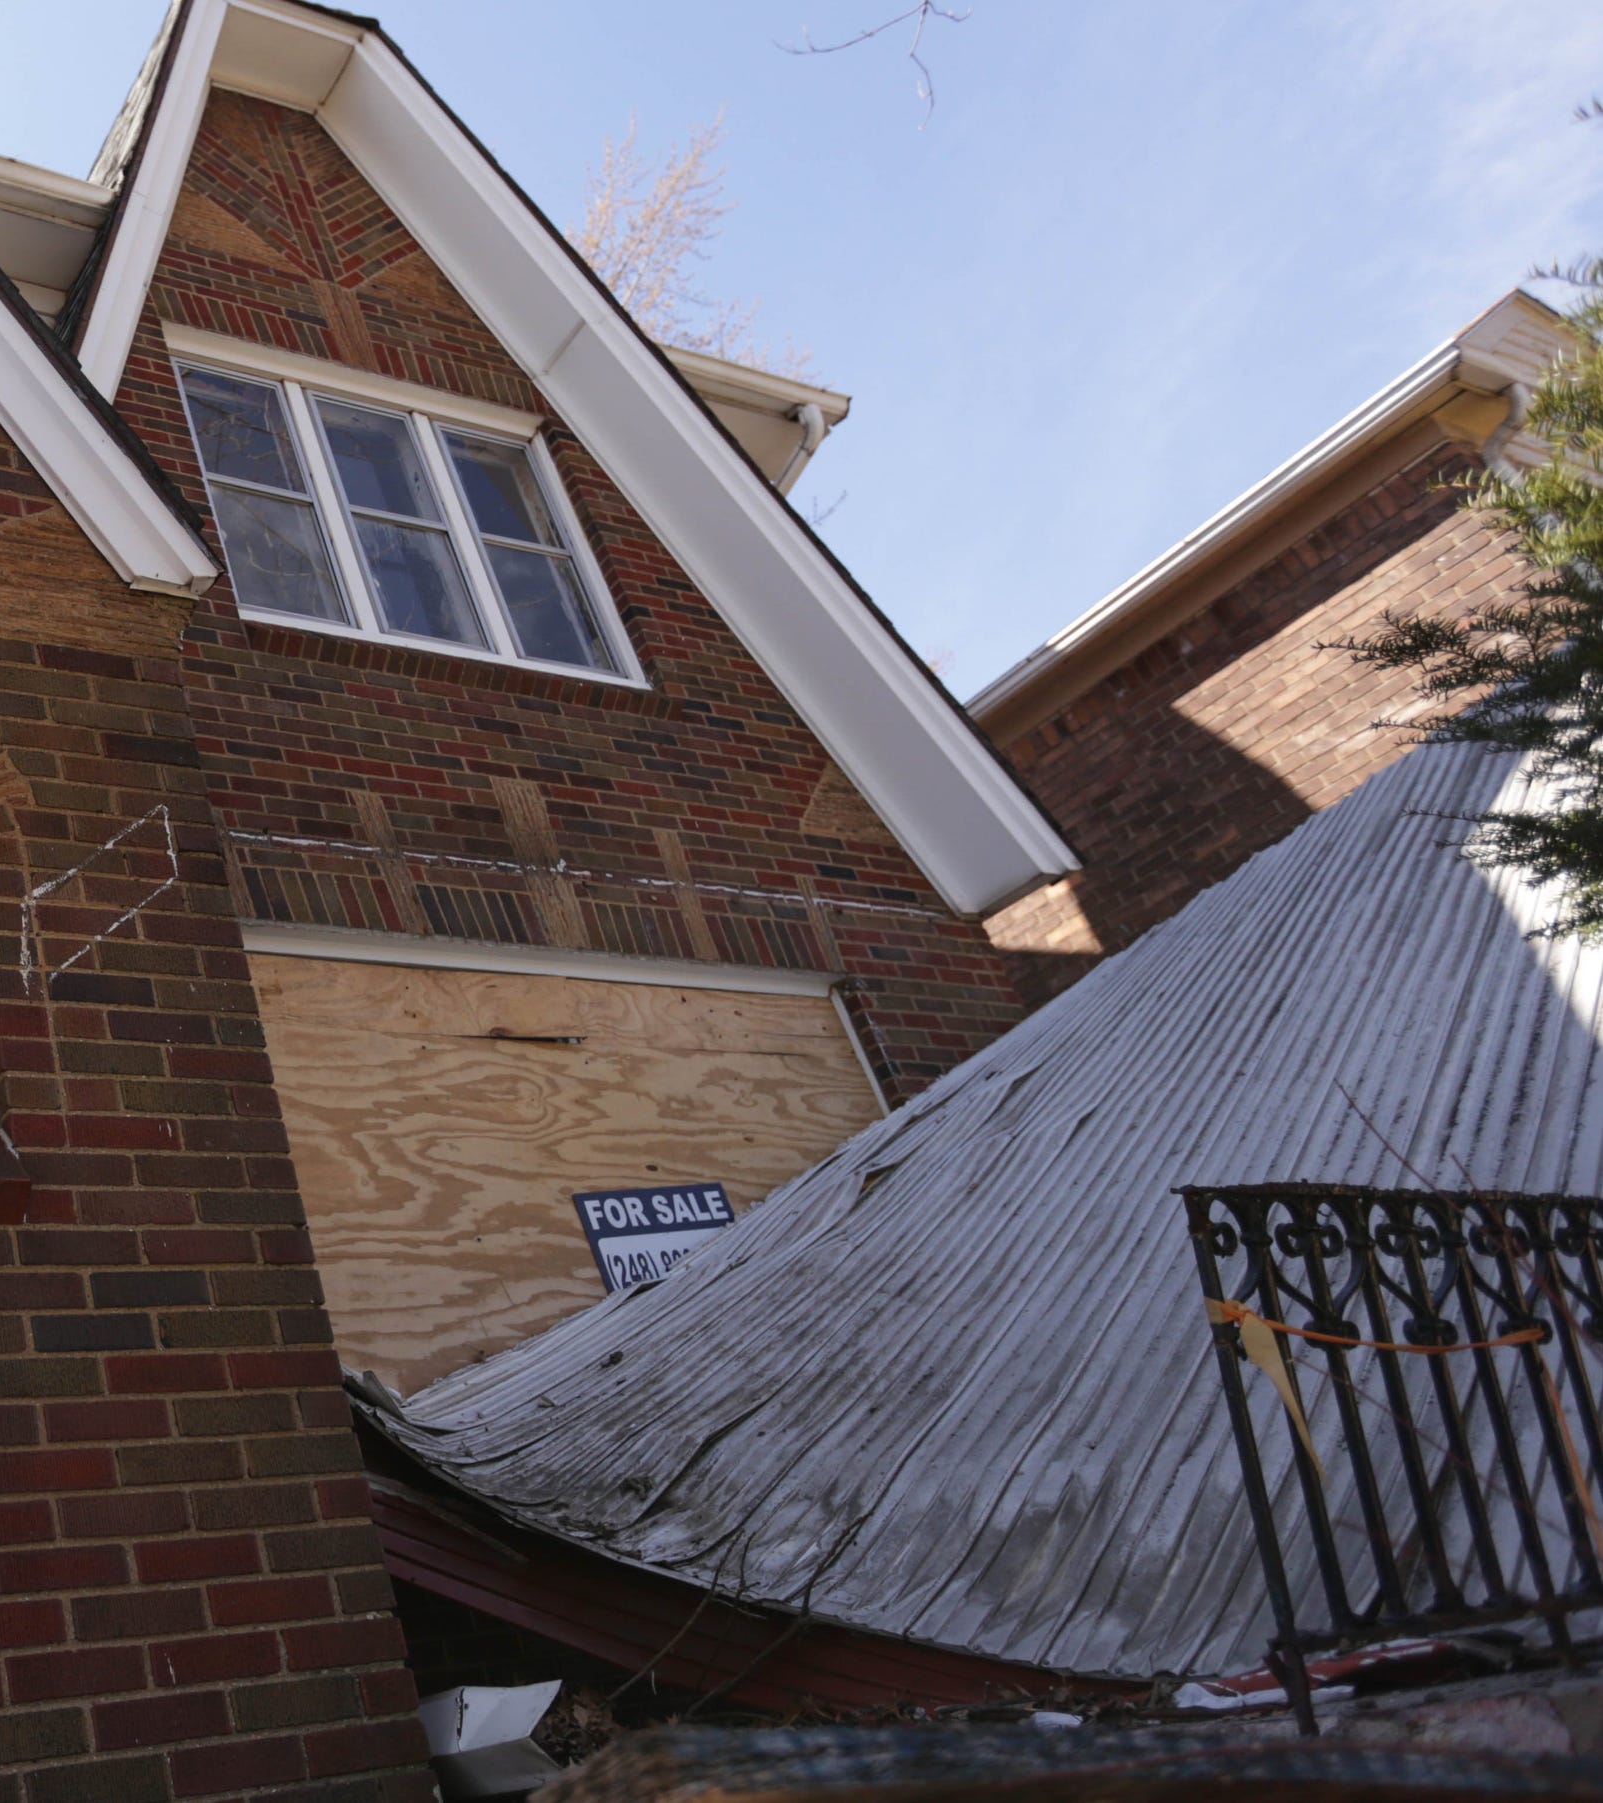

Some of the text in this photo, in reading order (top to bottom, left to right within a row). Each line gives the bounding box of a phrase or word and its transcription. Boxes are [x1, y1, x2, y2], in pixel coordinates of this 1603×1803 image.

[583, 1190, 729, 1230] FOR SALE
[607, 1250, 660, 1290] (248)
